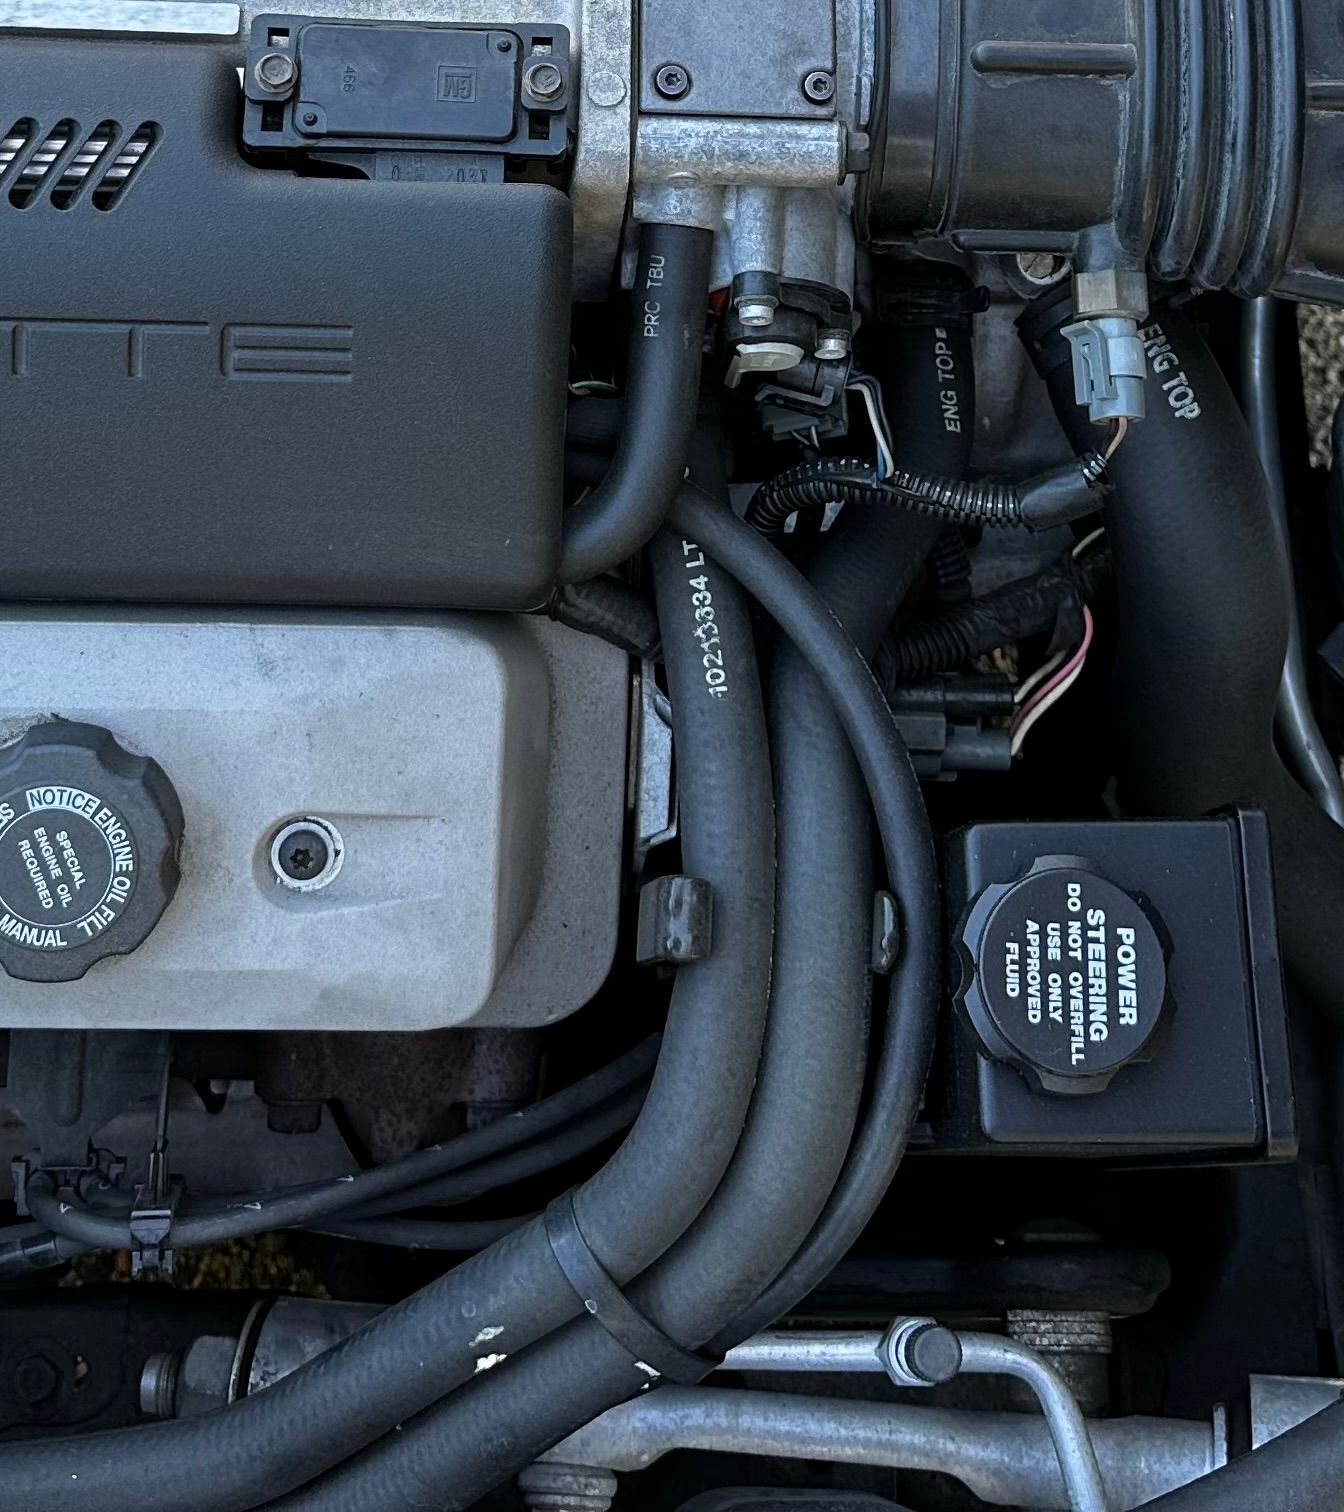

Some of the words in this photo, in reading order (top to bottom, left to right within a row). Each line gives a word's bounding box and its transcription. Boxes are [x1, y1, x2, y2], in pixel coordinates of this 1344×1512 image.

[342, 64, 357, 94] 466
[443, 70, 474, 100] GM
[648, 255, 666, 295] TBU
[643, 302, 661, 338] PRC
[936, 342, 958, 385] TOP
[1140, 322, 1180, 375] ENG
[1161, 370, 1201, 421] TOP
[944, 388, 961, 434] ENG
[682, 540, 704, 568] LT
[29, 789, 96, 814] NOTICE
[56, 830, 87, 890] SPECIAL
[94, 808, 133, 872] ENGINE
[18, 839, 54, 909] REQUIRED
[34, 827, 62, 880] ENGINE
[57, 883, 73, 908] OIL
[106, 876, 130, 904] OIL
[1067, 883, 1081, 911] DO
[77, 905, 115, 936] FILL
[1047, 923, 1061, 961] USE
[1068, 921, 1081, 961] NOT
[1005, 942, 1020, 997] FLUID
[1026, 919, 1041, 1024] APPROVED
[1086, 907, 1109, 1043] STEERING
[1116, 926, 1139, 1027] POWER
[1048, 973, 1063, 1024] ONLY
[1068, 971, 1085, 1065] OVERFILL
